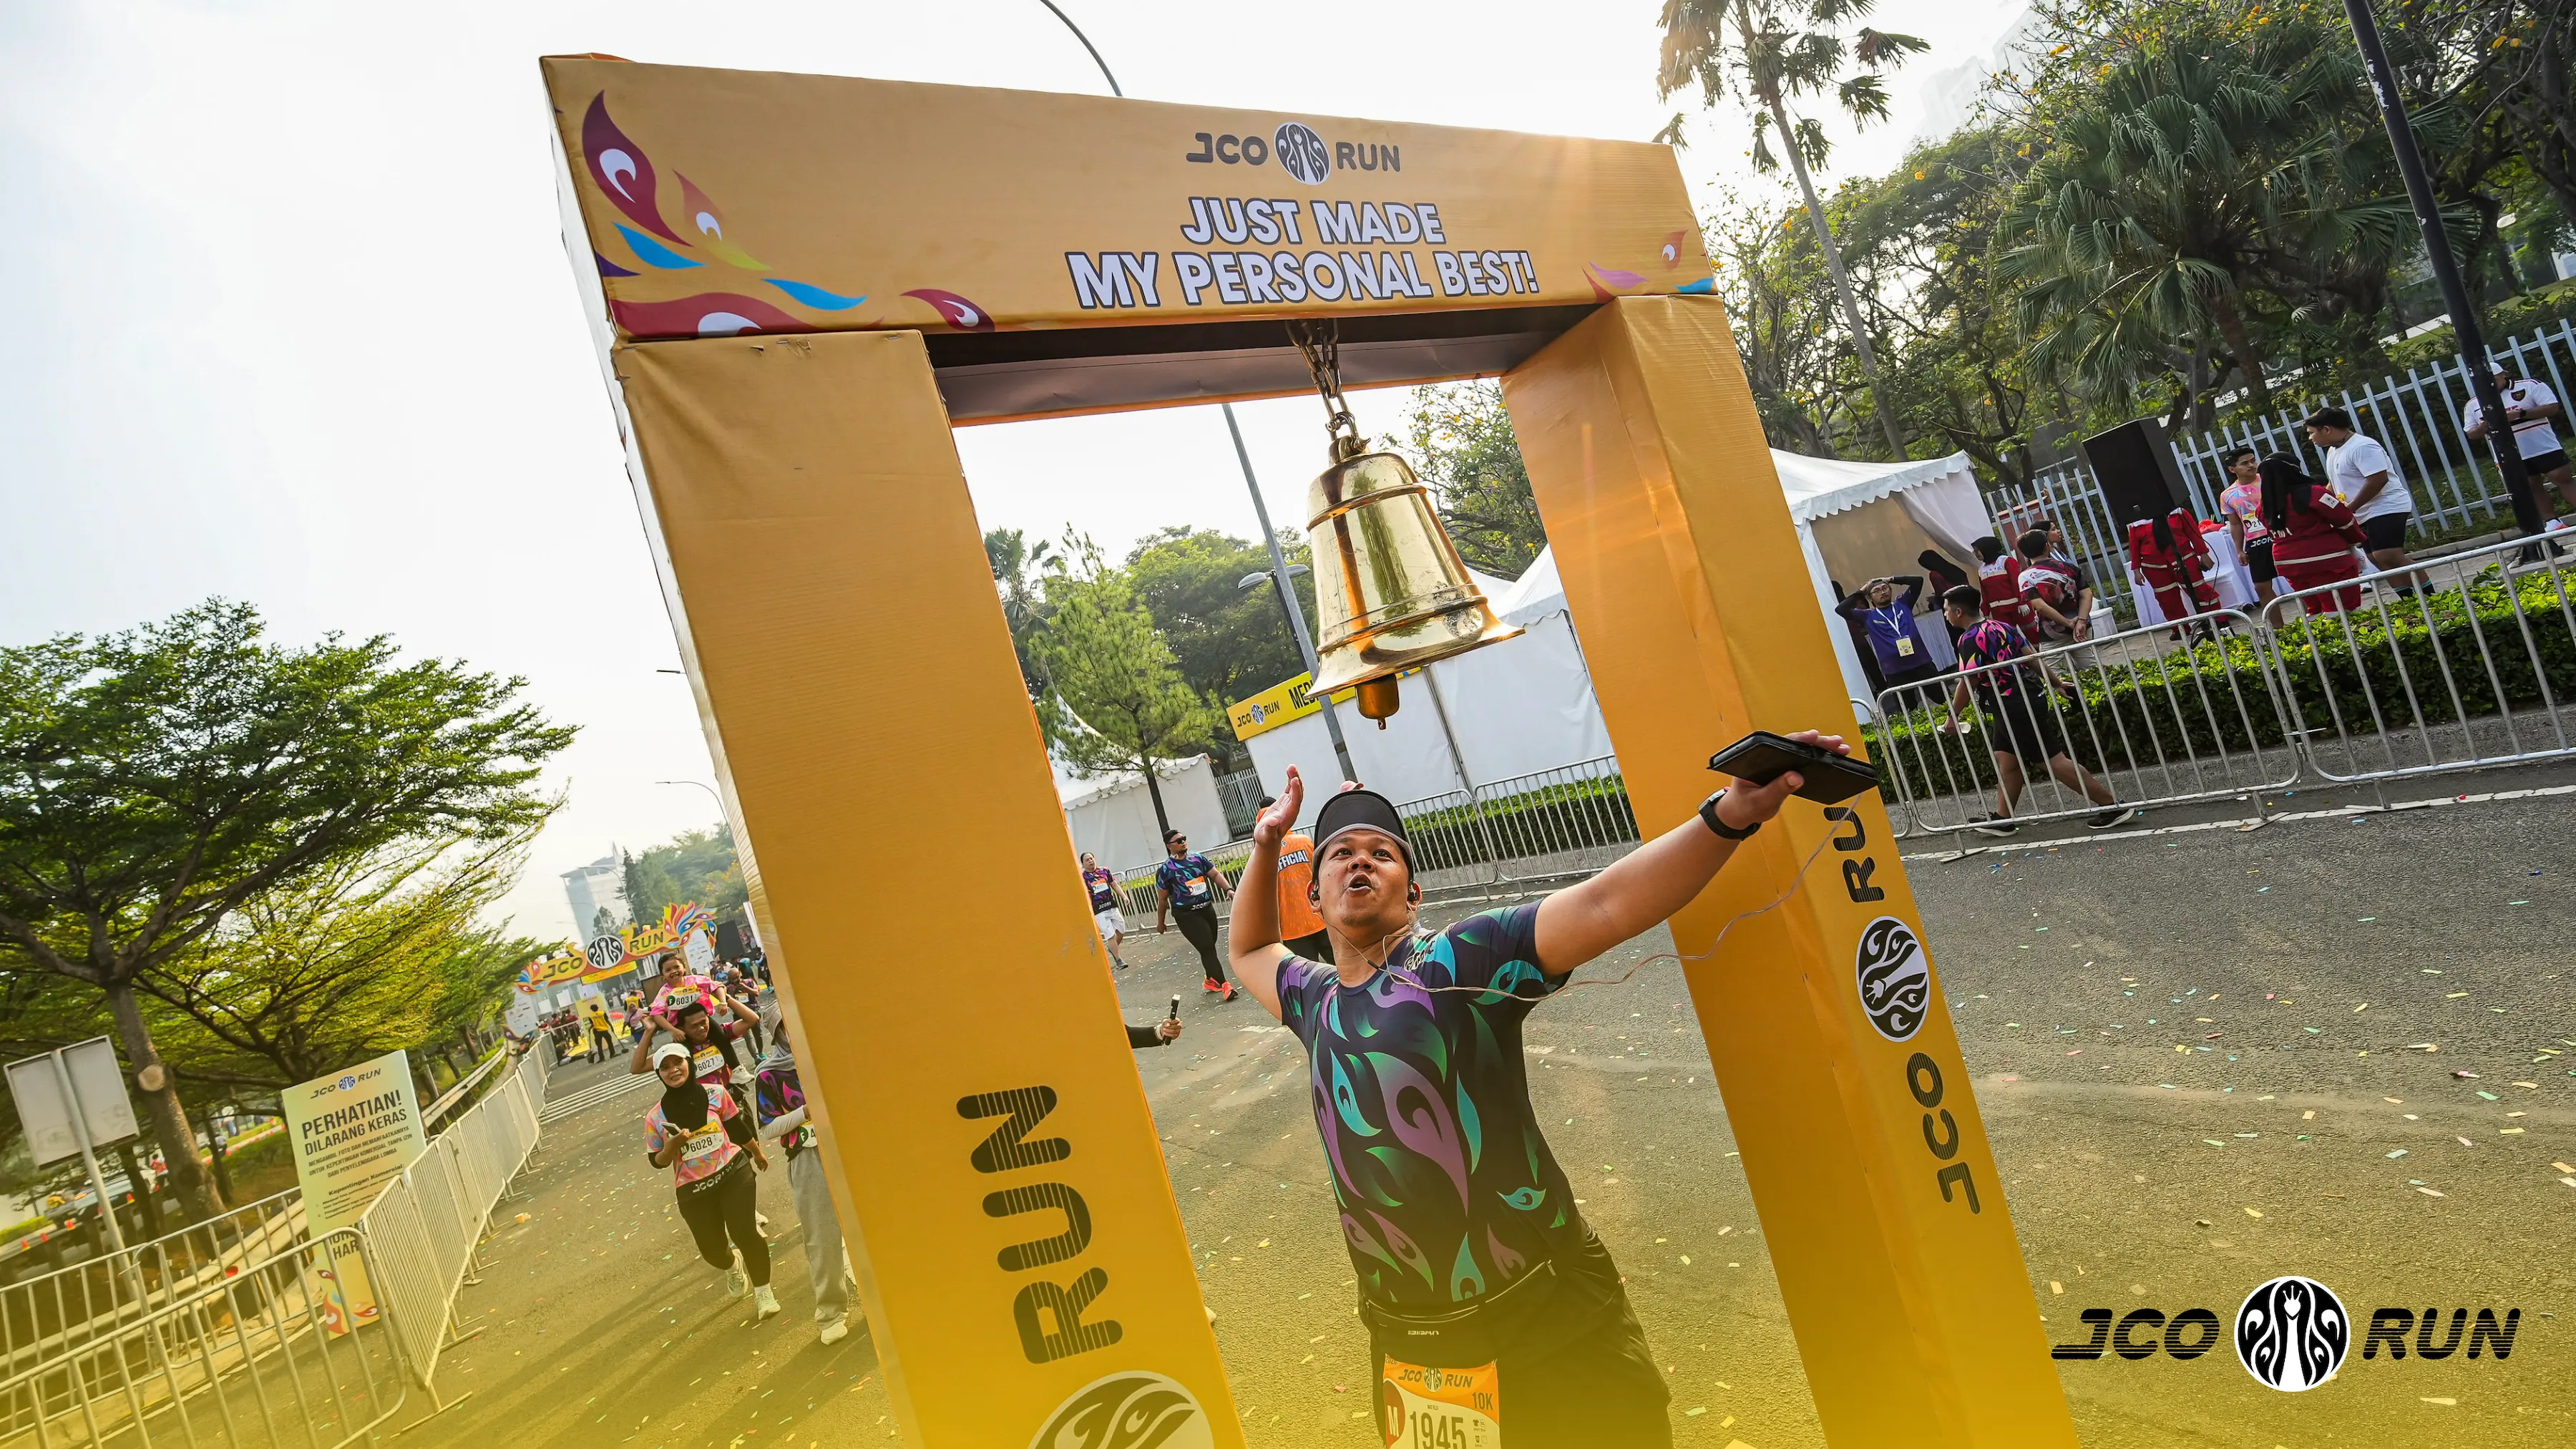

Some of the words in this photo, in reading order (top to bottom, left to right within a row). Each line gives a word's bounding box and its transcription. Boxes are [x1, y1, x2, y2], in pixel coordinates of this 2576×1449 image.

[1186, 132, 1268, 165] JCO
[1335, 141, 1401, 172] RUN
[1180, 197, 1302, 245] JUST
[1311, 200, 1446, 245] MADE
[1064, 251, 1161, 309] MY
[1171, 250, 1434, 306] PERSONAL
[1435, 249, 1539, 298] BEST!
[2250, 537, 2273, 547] JCOR
[1236, 713, 1252, 728] JCO
[1264, 701, 1280, 716] RUN
[1277, 849, 1310, 872] FFICIAL
[1823, 806, 1885, 903] RU
[542, 957, 583, 979] JCO
[630, 931, 664, 952] RUN
[675, 995, 693, 1005] 6031
[698, 1058, 715, 1071] 6027
[310, 1084, 336, 1099] JCO
[358, 1068, 381, 1083] RUN
[301, 1089, 402, 1139] PERHATIAN!
[304, 1123, 366, 1156] DILARANG
[368, 1108, 407, 1133] KERAS
[680, 1145, 688, 1154] M
[690, 1136, 713, 1152] 6028
[1906, 1052, 1981, 1215] JCO
[308, 1166, 326, 1176] UNTUK
[326, 1151, 360, 1170] KEPENTINGAN
[360, 1143, 387, 1156] KOMERSIAL
[387, 1138, 403, 1146] TANPA
[308, 1153, 338, 1167] MENGAMBIL
[338, 1148, 351, 1156] FOTO
[328, 1170, 340, 1179] DARI
[381, 1148, 397, 1159] LOMBA
[328, 1177, 370, 1196] Kepentingan
[956, 1085, 1124, 1365] RUN
[333, 1239, 360, 1260] HAR
[1397, 1369, 1423, 1383] JCO
[1444, 1373, 1473, 1389] RUN
[1471, 1392, 1494, 1411] 10K
[1387, 1405, 1400, 1438] M
[1410, 1410, 1467, 1449] 1945
